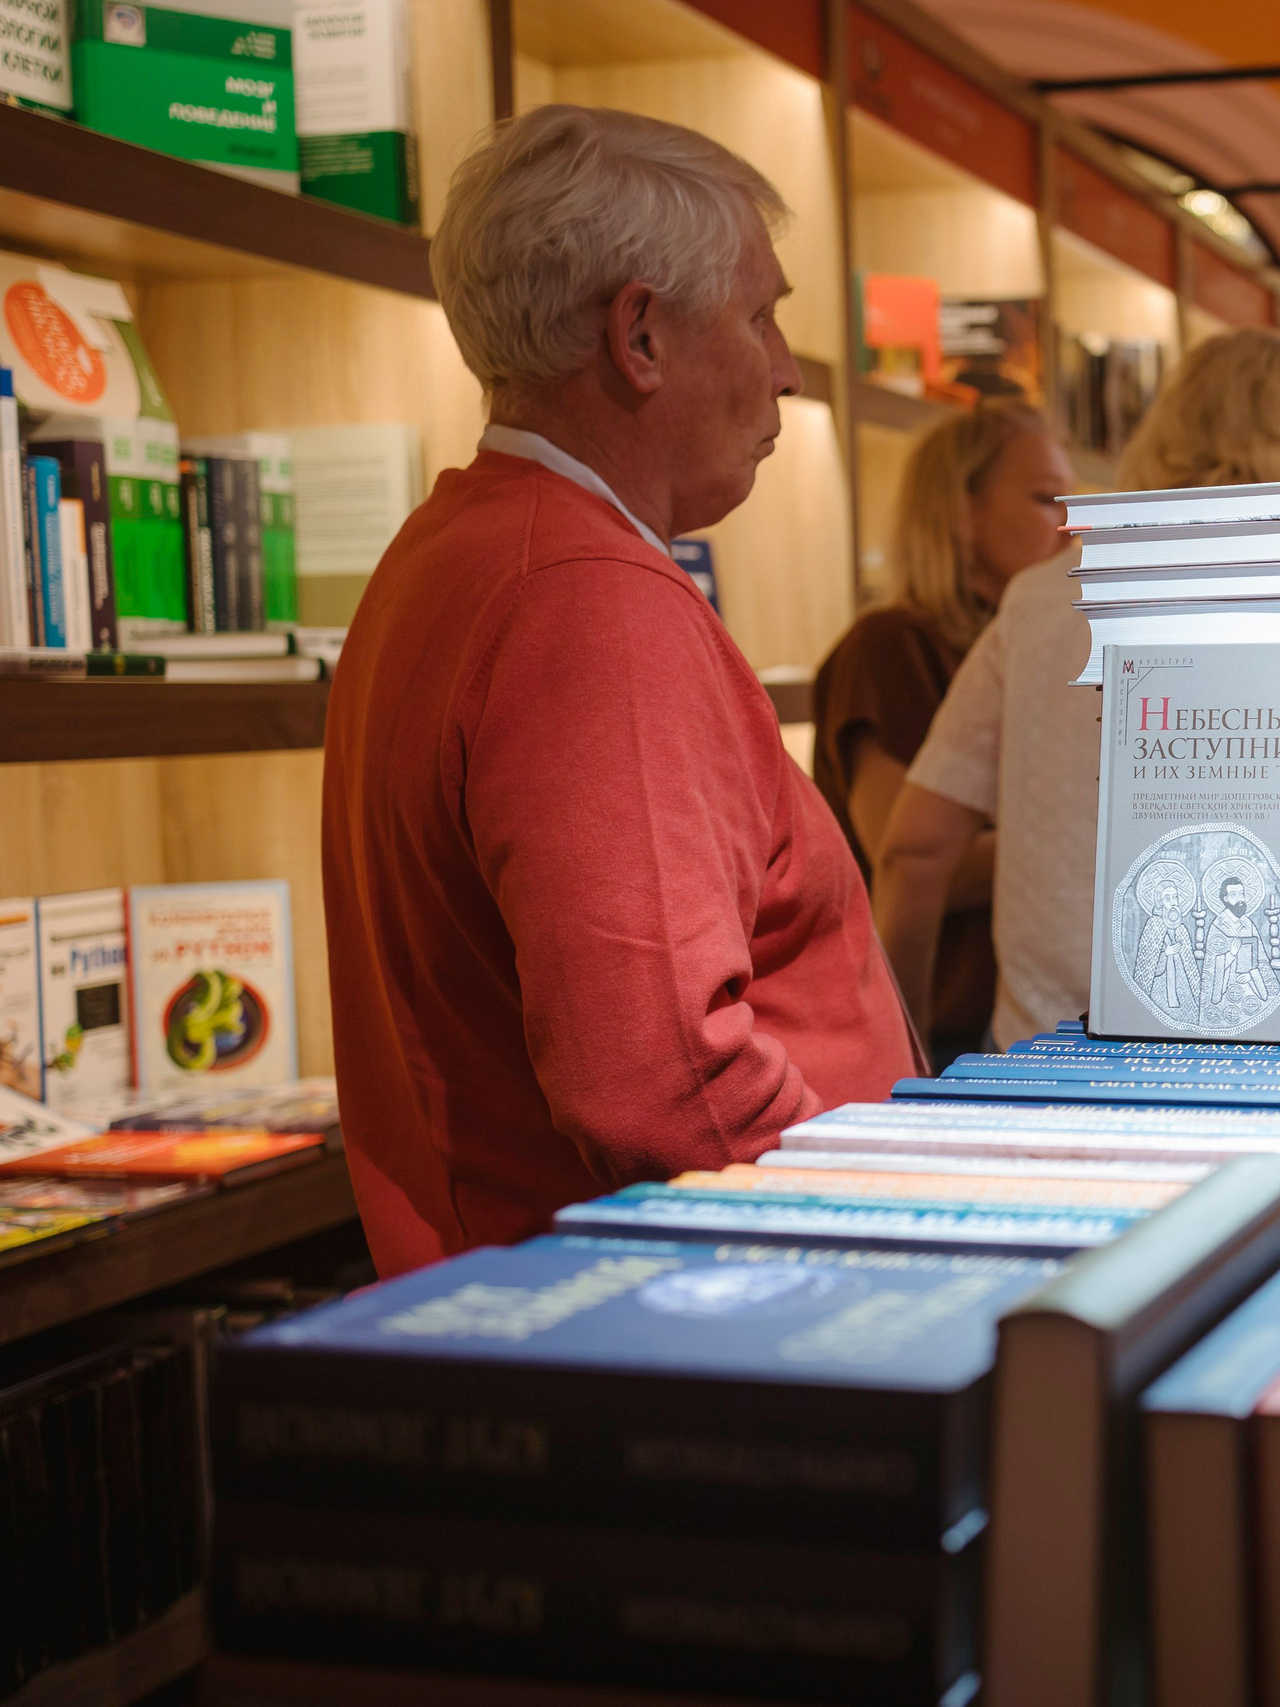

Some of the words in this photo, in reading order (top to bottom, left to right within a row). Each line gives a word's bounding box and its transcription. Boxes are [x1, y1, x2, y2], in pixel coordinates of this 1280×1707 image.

[2, 50, 63, 83] КЛЕТКИ
[225, 75, 276, 99] МОЗГ
[168, 101, 278, 134] ПОВЕДЕНИЕ
[1117, 679, 1125, 746] ИСТОРИЯ
[1133, 766, 1146, 779] И
[1154, 766, 1180, 779] ИХ
[1186, 765, 1269, 779] ЗЕМНЫЕ
[1133, 792, 1197, 801] ПРЕДМЕТНЫЙ
[1199, 793, 1219, 801] МИР
[1139, 803, 1179, 811] ЗЕРКАЛЕ
[1180, 802, 1228, 811] СВЕТСКОЙ
[1132, 812, 1209, 820] ДВУИМЕННОСТИ
[1254, 812, 1270, 820] ВВ.)
[1122, 1041, 1279, 1052] ИСЛАНДСКИЕ
[1122, 1057, 1232, 1066] ИСТОРИЯ
